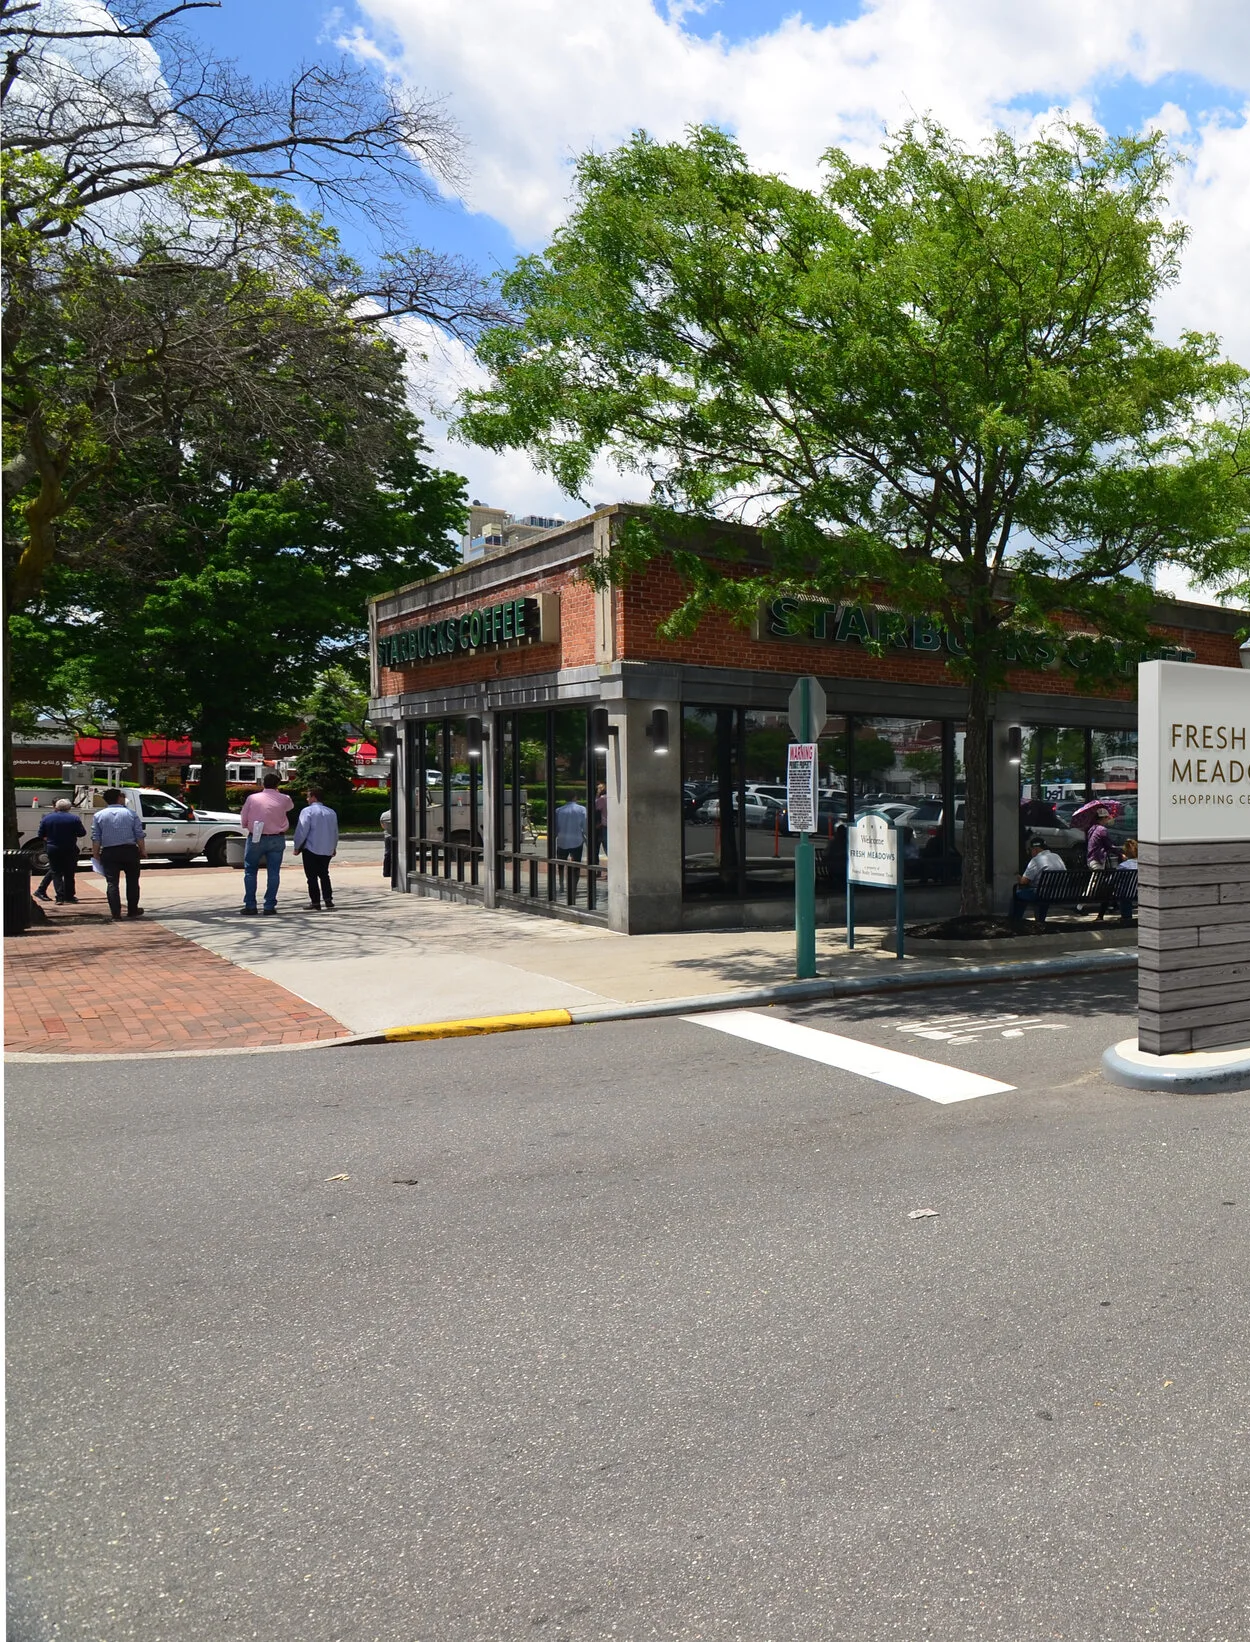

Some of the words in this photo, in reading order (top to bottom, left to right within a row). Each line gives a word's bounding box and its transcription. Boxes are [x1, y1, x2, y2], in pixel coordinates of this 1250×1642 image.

[460, 598, 526, 649] COFFEE
[770, 596, 1057, 666] STARBUKS
[1172, 724, 1246, 750] FRESH
[790, 746, 812, 760] WARNING
[1172, 794, 1234, 804] SHOPPING
[861, 835, 884, 845] Welcome
[850, 850, 865, 858] FRESH
[868, 852, 895, 861] MEADOWS
